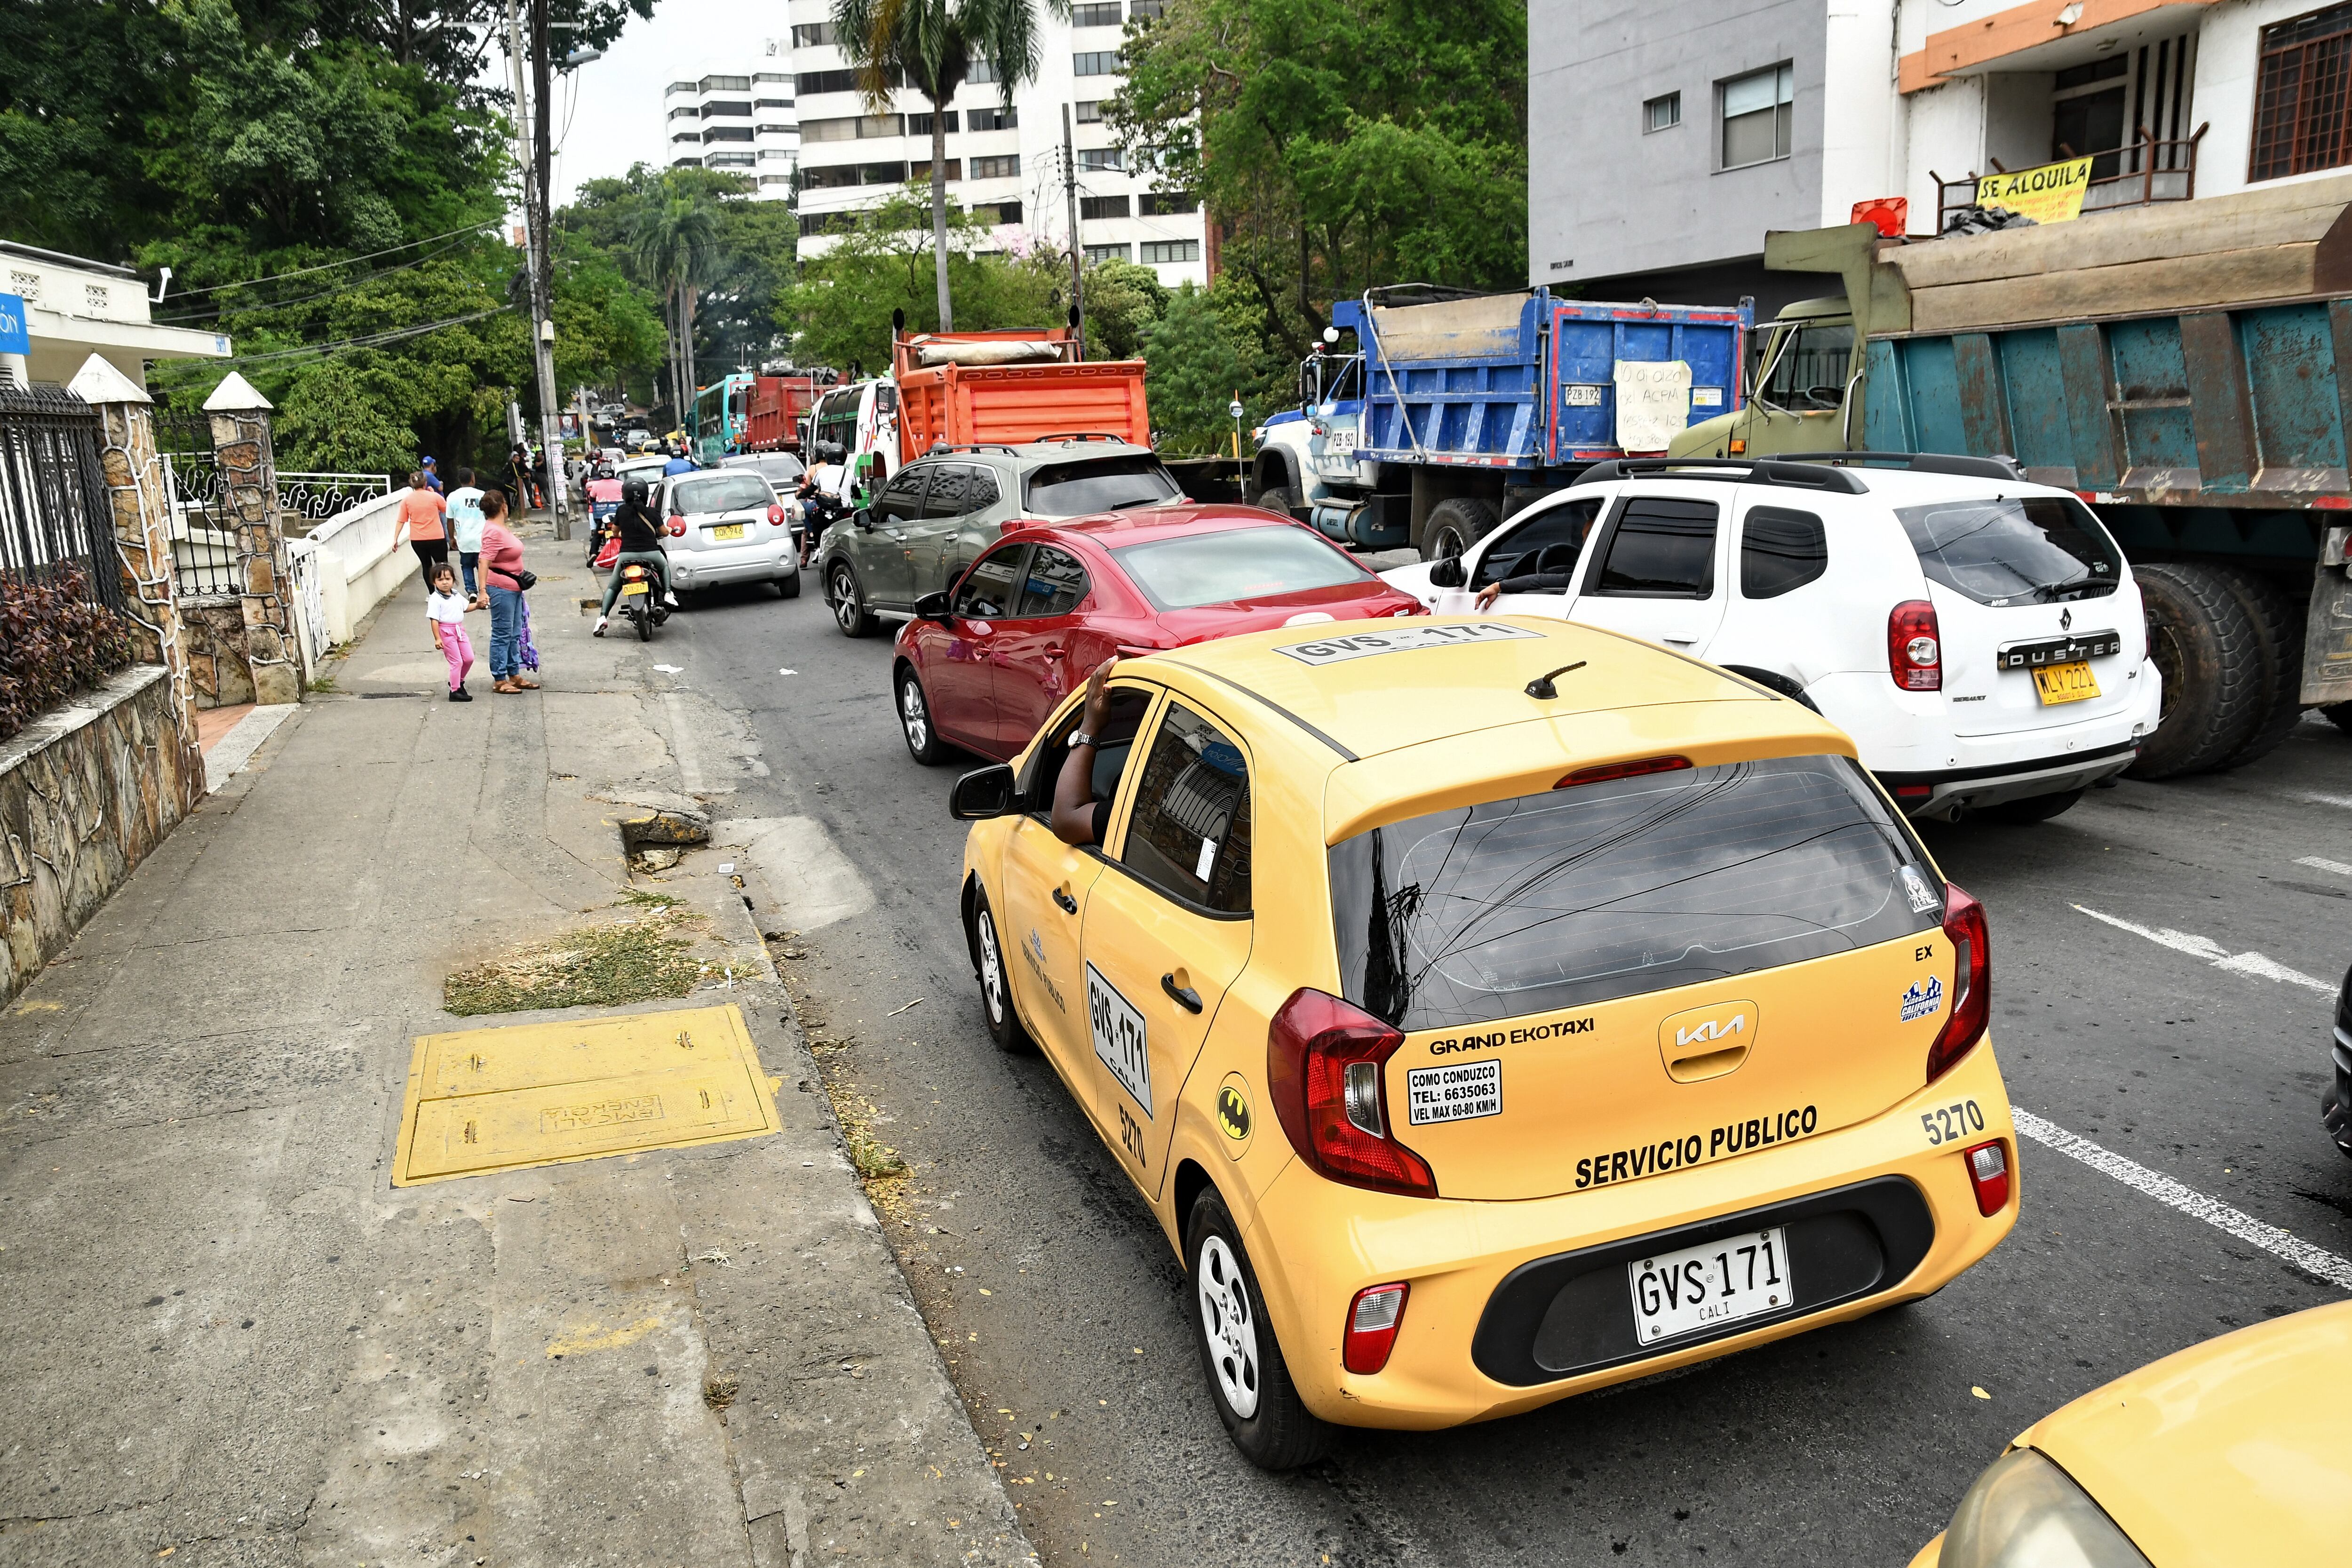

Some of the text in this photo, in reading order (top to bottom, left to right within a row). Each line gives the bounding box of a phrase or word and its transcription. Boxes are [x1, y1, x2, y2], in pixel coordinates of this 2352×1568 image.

[1981, 163, 2087, 199] SE ALQUILA
[1643, 388, 1678, 404] ACPM
[1295, 624, 1517, 657] GVS 171
[2010, 642, 2120, 666] DUSTER
[2037, 666, 2094, 694] WLV 221
[1915, 944, 1932, 962] EX
[1042, 970, 1065, 1015] PUBLICO
[1901, 995, 1940, 1016] CALIFORNIA
[1090, 980, 1146, 1085] GVS 171
[1430, 1017, 1594, 1055] GRAND EKOTAXI
[1109, 1057, 1136, 1092] CALI
[1412, 1066, 1495, 1088] COMO CONDUZCO
[1413, 1082, 1496, 1104] TEL: 6635063
[1414, 1098, 1496, 1121] VEL MAX 60-80 KM/H
[1118, 1102, 1146, 1169] 5270
[1921, 1099, 1985, 1146] 5270
[1574, 1105, 1818, 1189] SERVICIO PUBLICO
[1637, 1240, 1782, 1317] GVS 171
[1699, 1301, 1730, 1321] CALI
